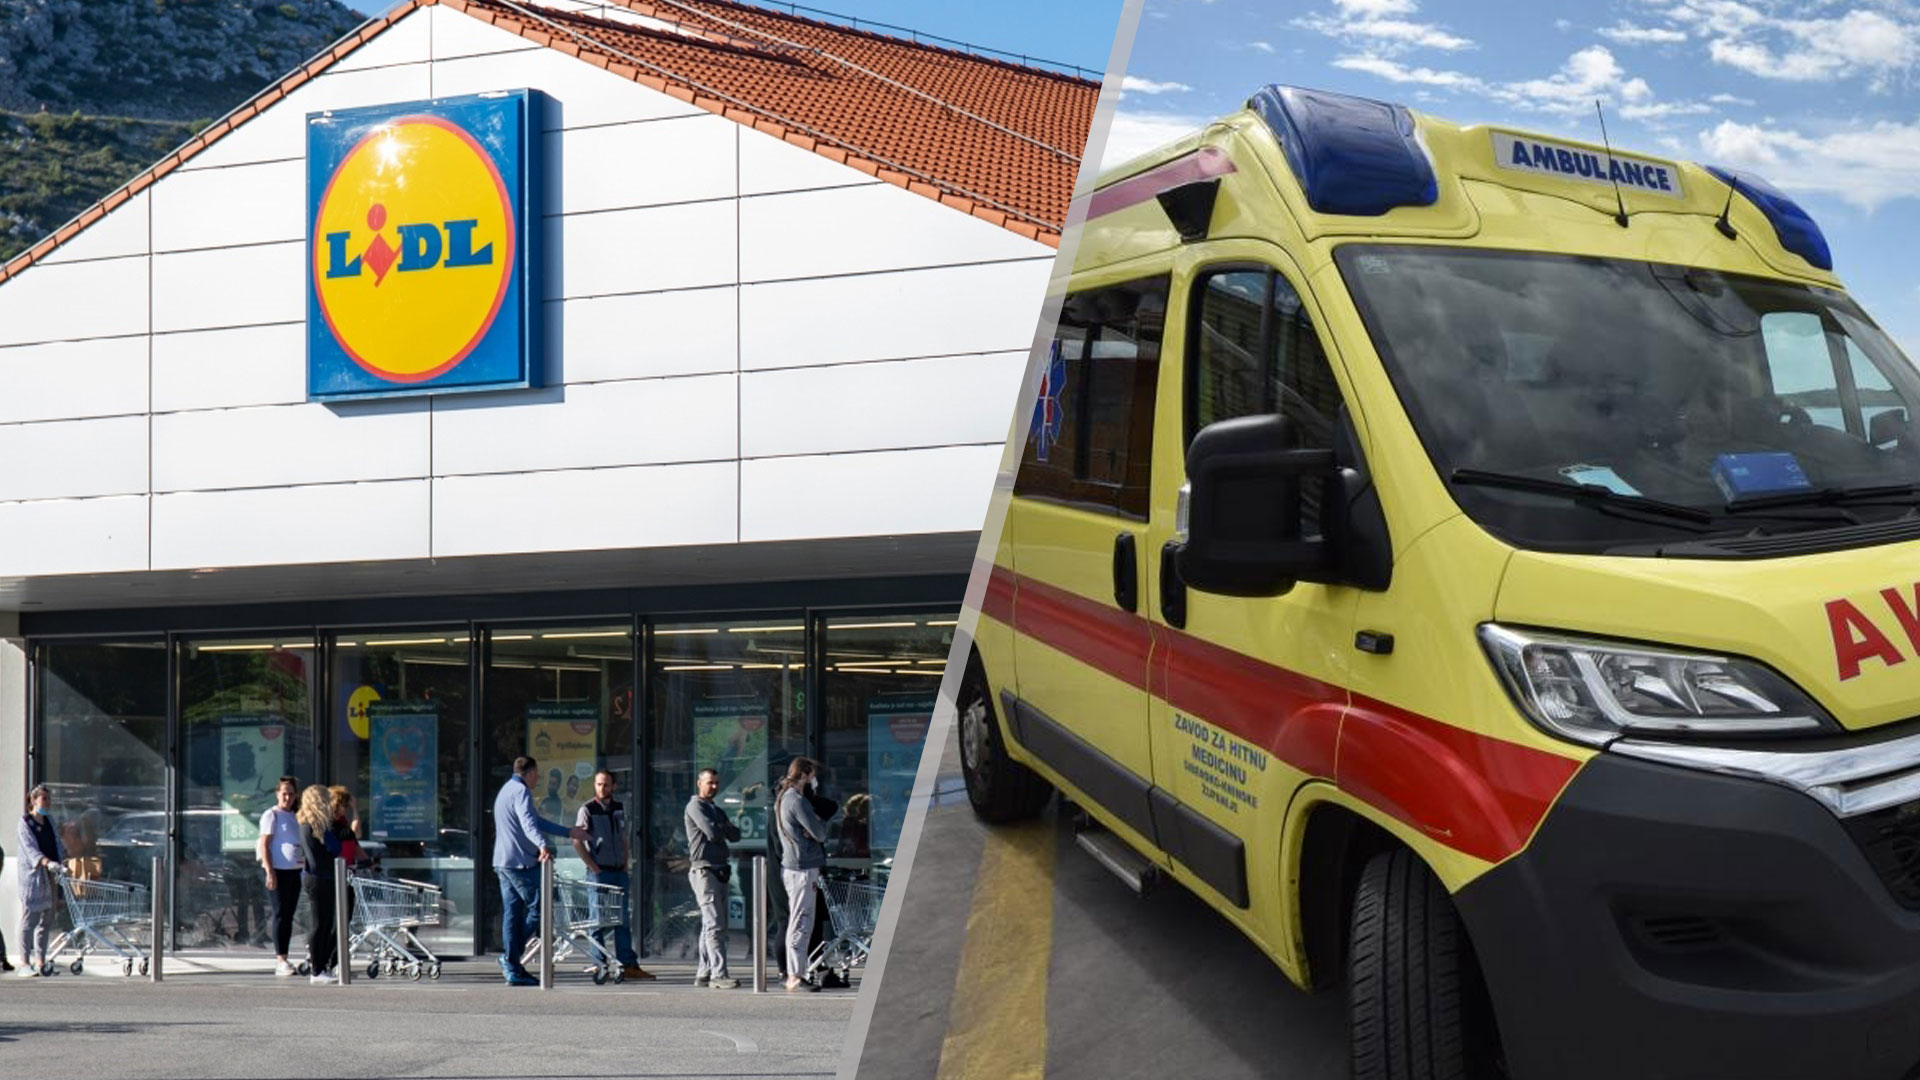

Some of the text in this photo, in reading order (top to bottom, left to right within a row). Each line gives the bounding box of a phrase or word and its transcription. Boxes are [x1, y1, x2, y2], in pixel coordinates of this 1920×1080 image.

[1512, 140, 1672, 191] AMBULANCE
[1175, 713, 1267, 772] ZAVOD ZA HITNU
[1192, 743, 1246, 785] MEDICINU
